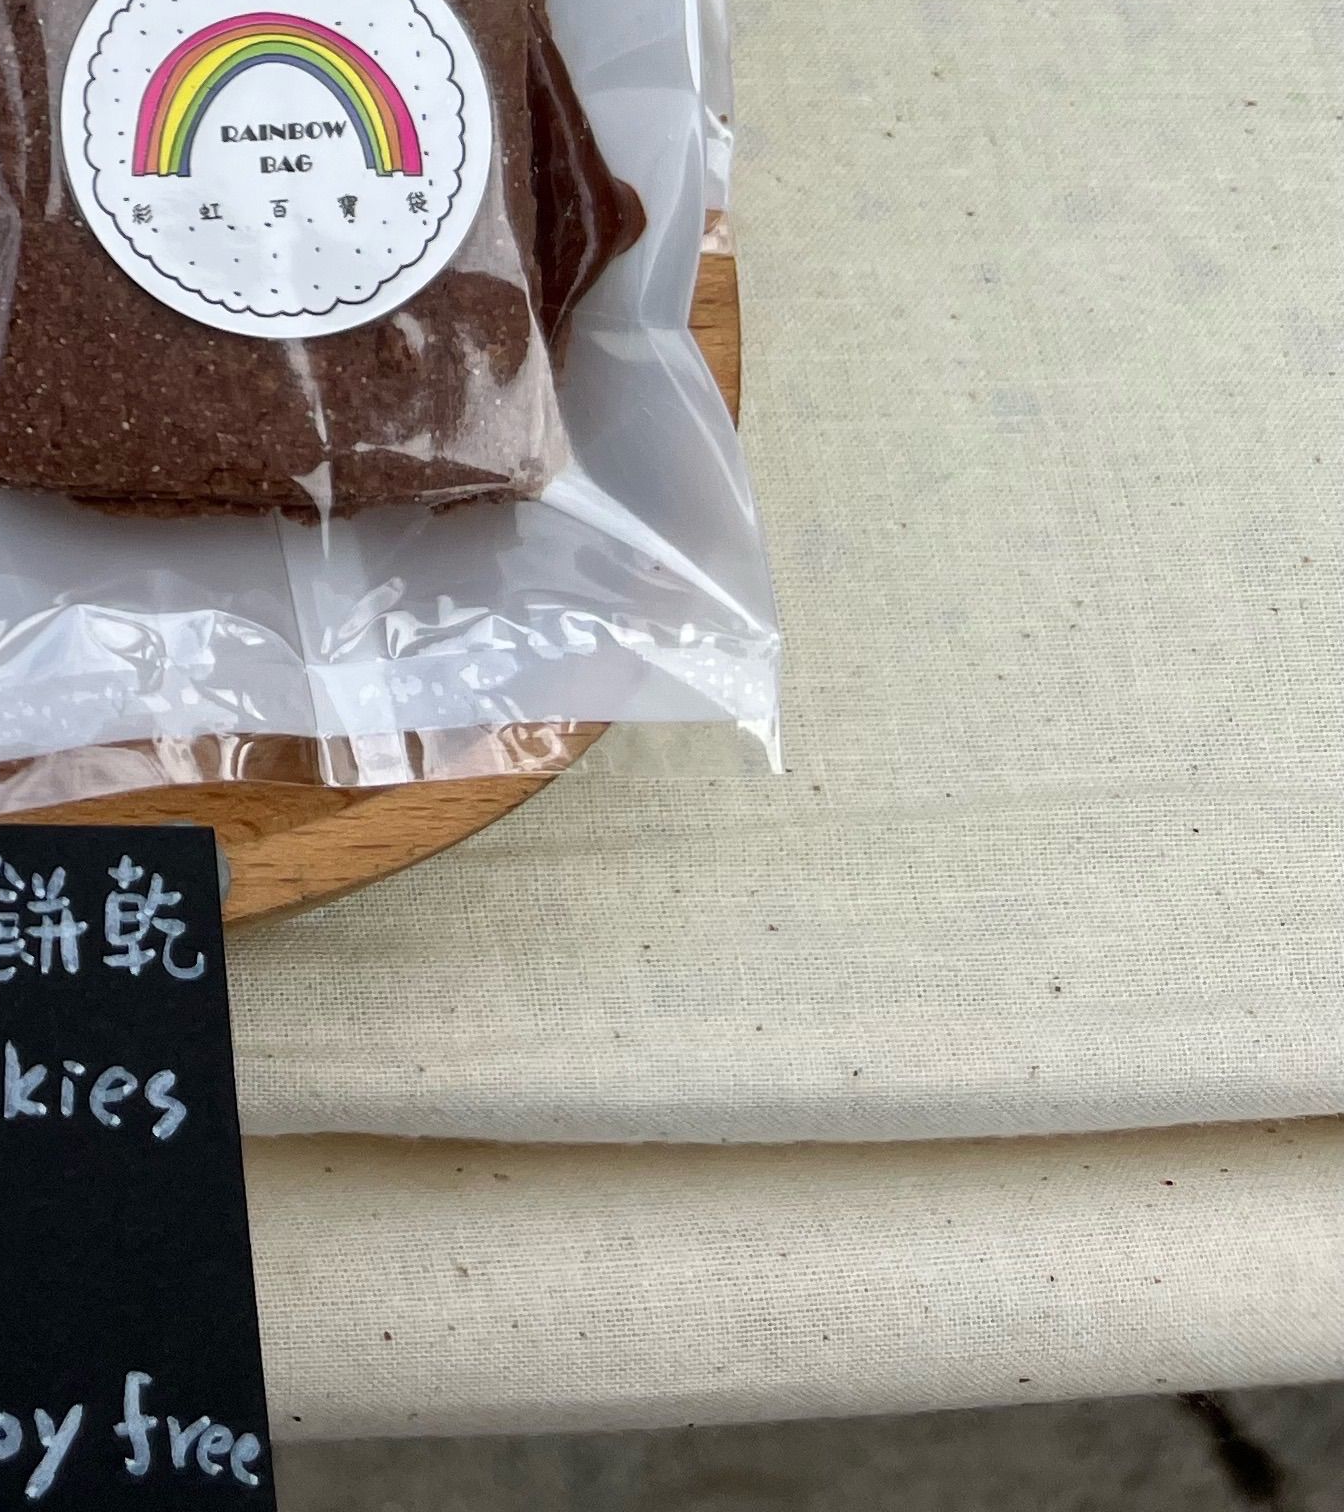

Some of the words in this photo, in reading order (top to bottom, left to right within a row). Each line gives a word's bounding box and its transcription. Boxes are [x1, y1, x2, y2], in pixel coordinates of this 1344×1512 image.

[221, 120, 347, 143] RAINBOW
[260, 154, 313, 174] BAG
[113, 1370, 261, 1488] free
